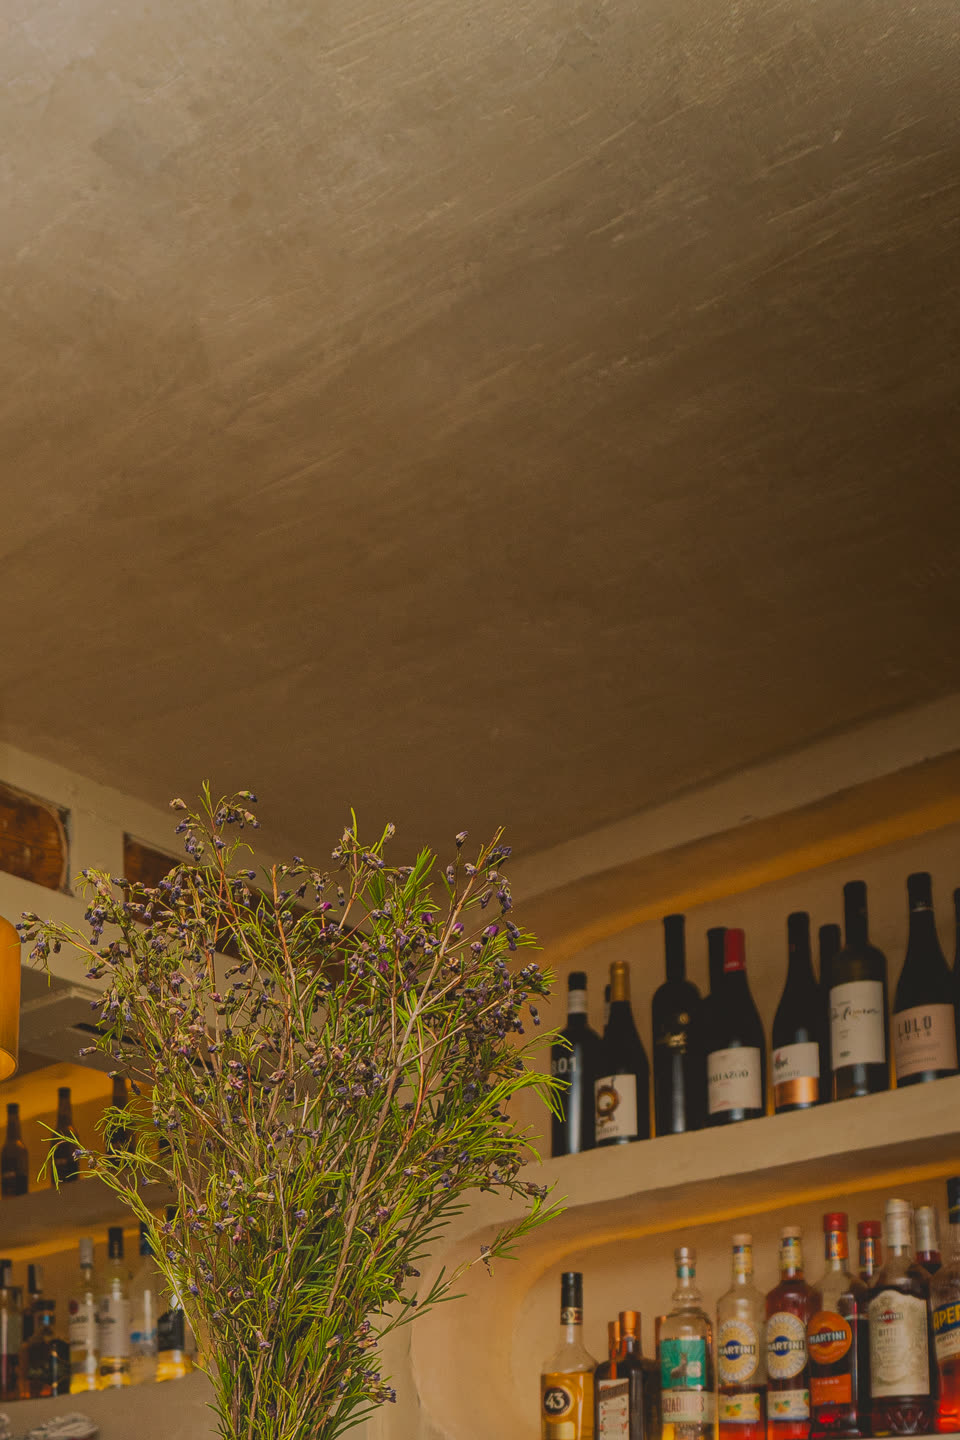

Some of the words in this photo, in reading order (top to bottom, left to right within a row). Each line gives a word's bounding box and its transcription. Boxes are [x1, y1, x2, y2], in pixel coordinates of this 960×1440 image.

[809, 1331, 846, 1344] MARTINI
[769, 1340, 804, 1352] MARTINI
[544, 1392, 566, 1410] 43
